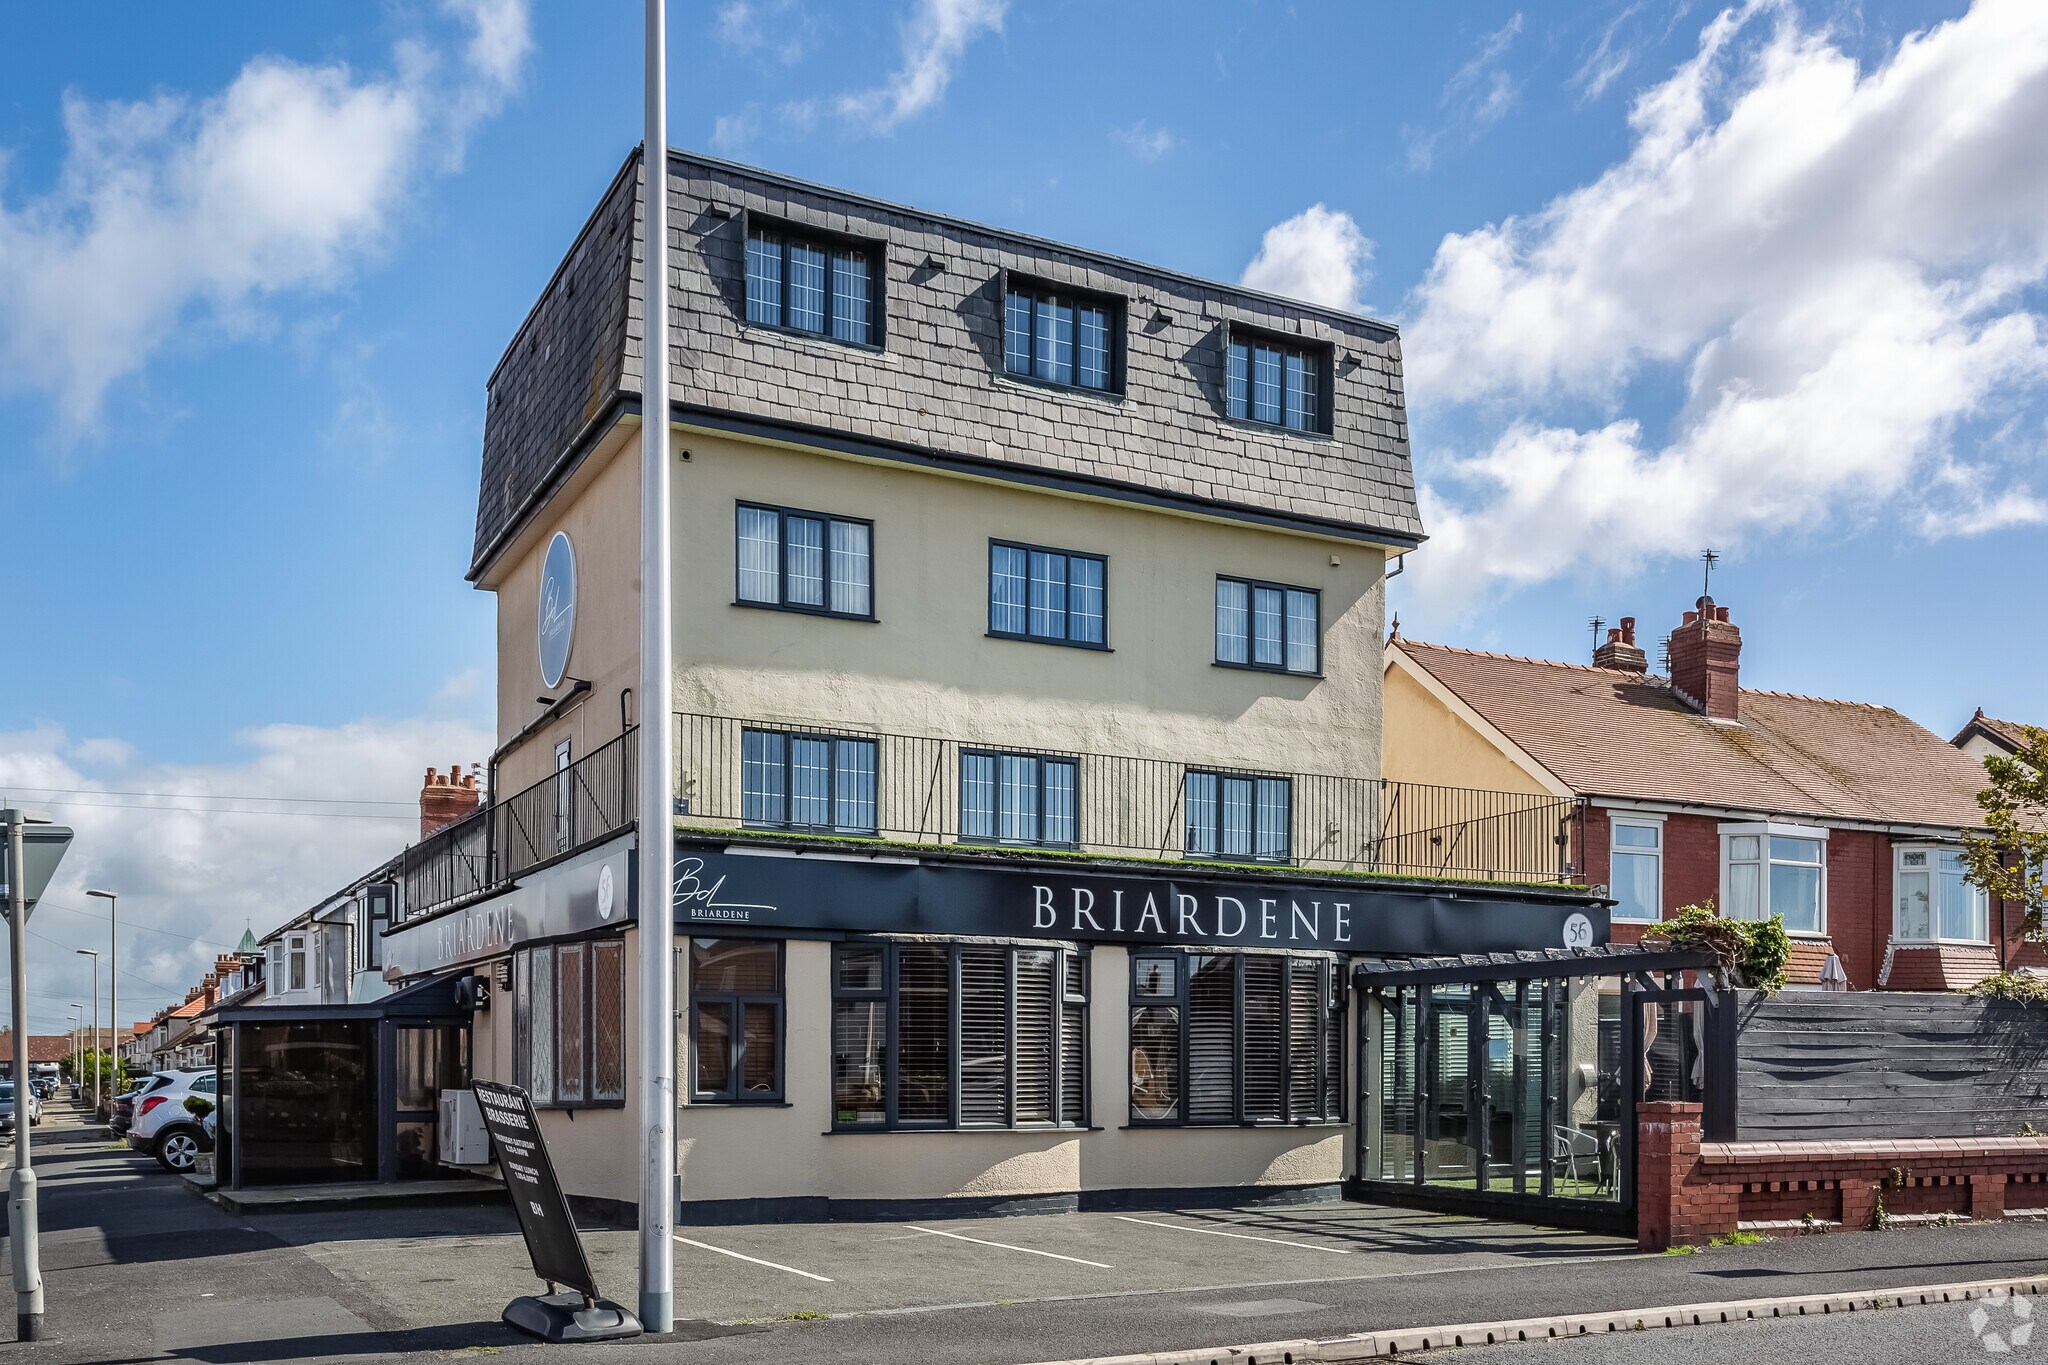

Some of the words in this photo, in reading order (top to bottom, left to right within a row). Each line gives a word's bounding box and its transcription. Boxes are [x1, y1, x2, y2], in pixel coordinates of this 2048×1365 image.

[691, 908, 750, 919] BRIARDENE
[1032, 885, 1350, 942] BRIARDENE
[437, 903, 514, 960] BRIARDENE
[1569, 921, 1587, 942] 56
[476, 1087, 526, 1112] RESTAURANT
[485, 1106, 530, 1130] BRASSERIE
[508, 1161, 524, 1172] SUNDAY
[523, 1166, 540, 1177] LUNCH
[529, 1201, 544, 1217] BH
